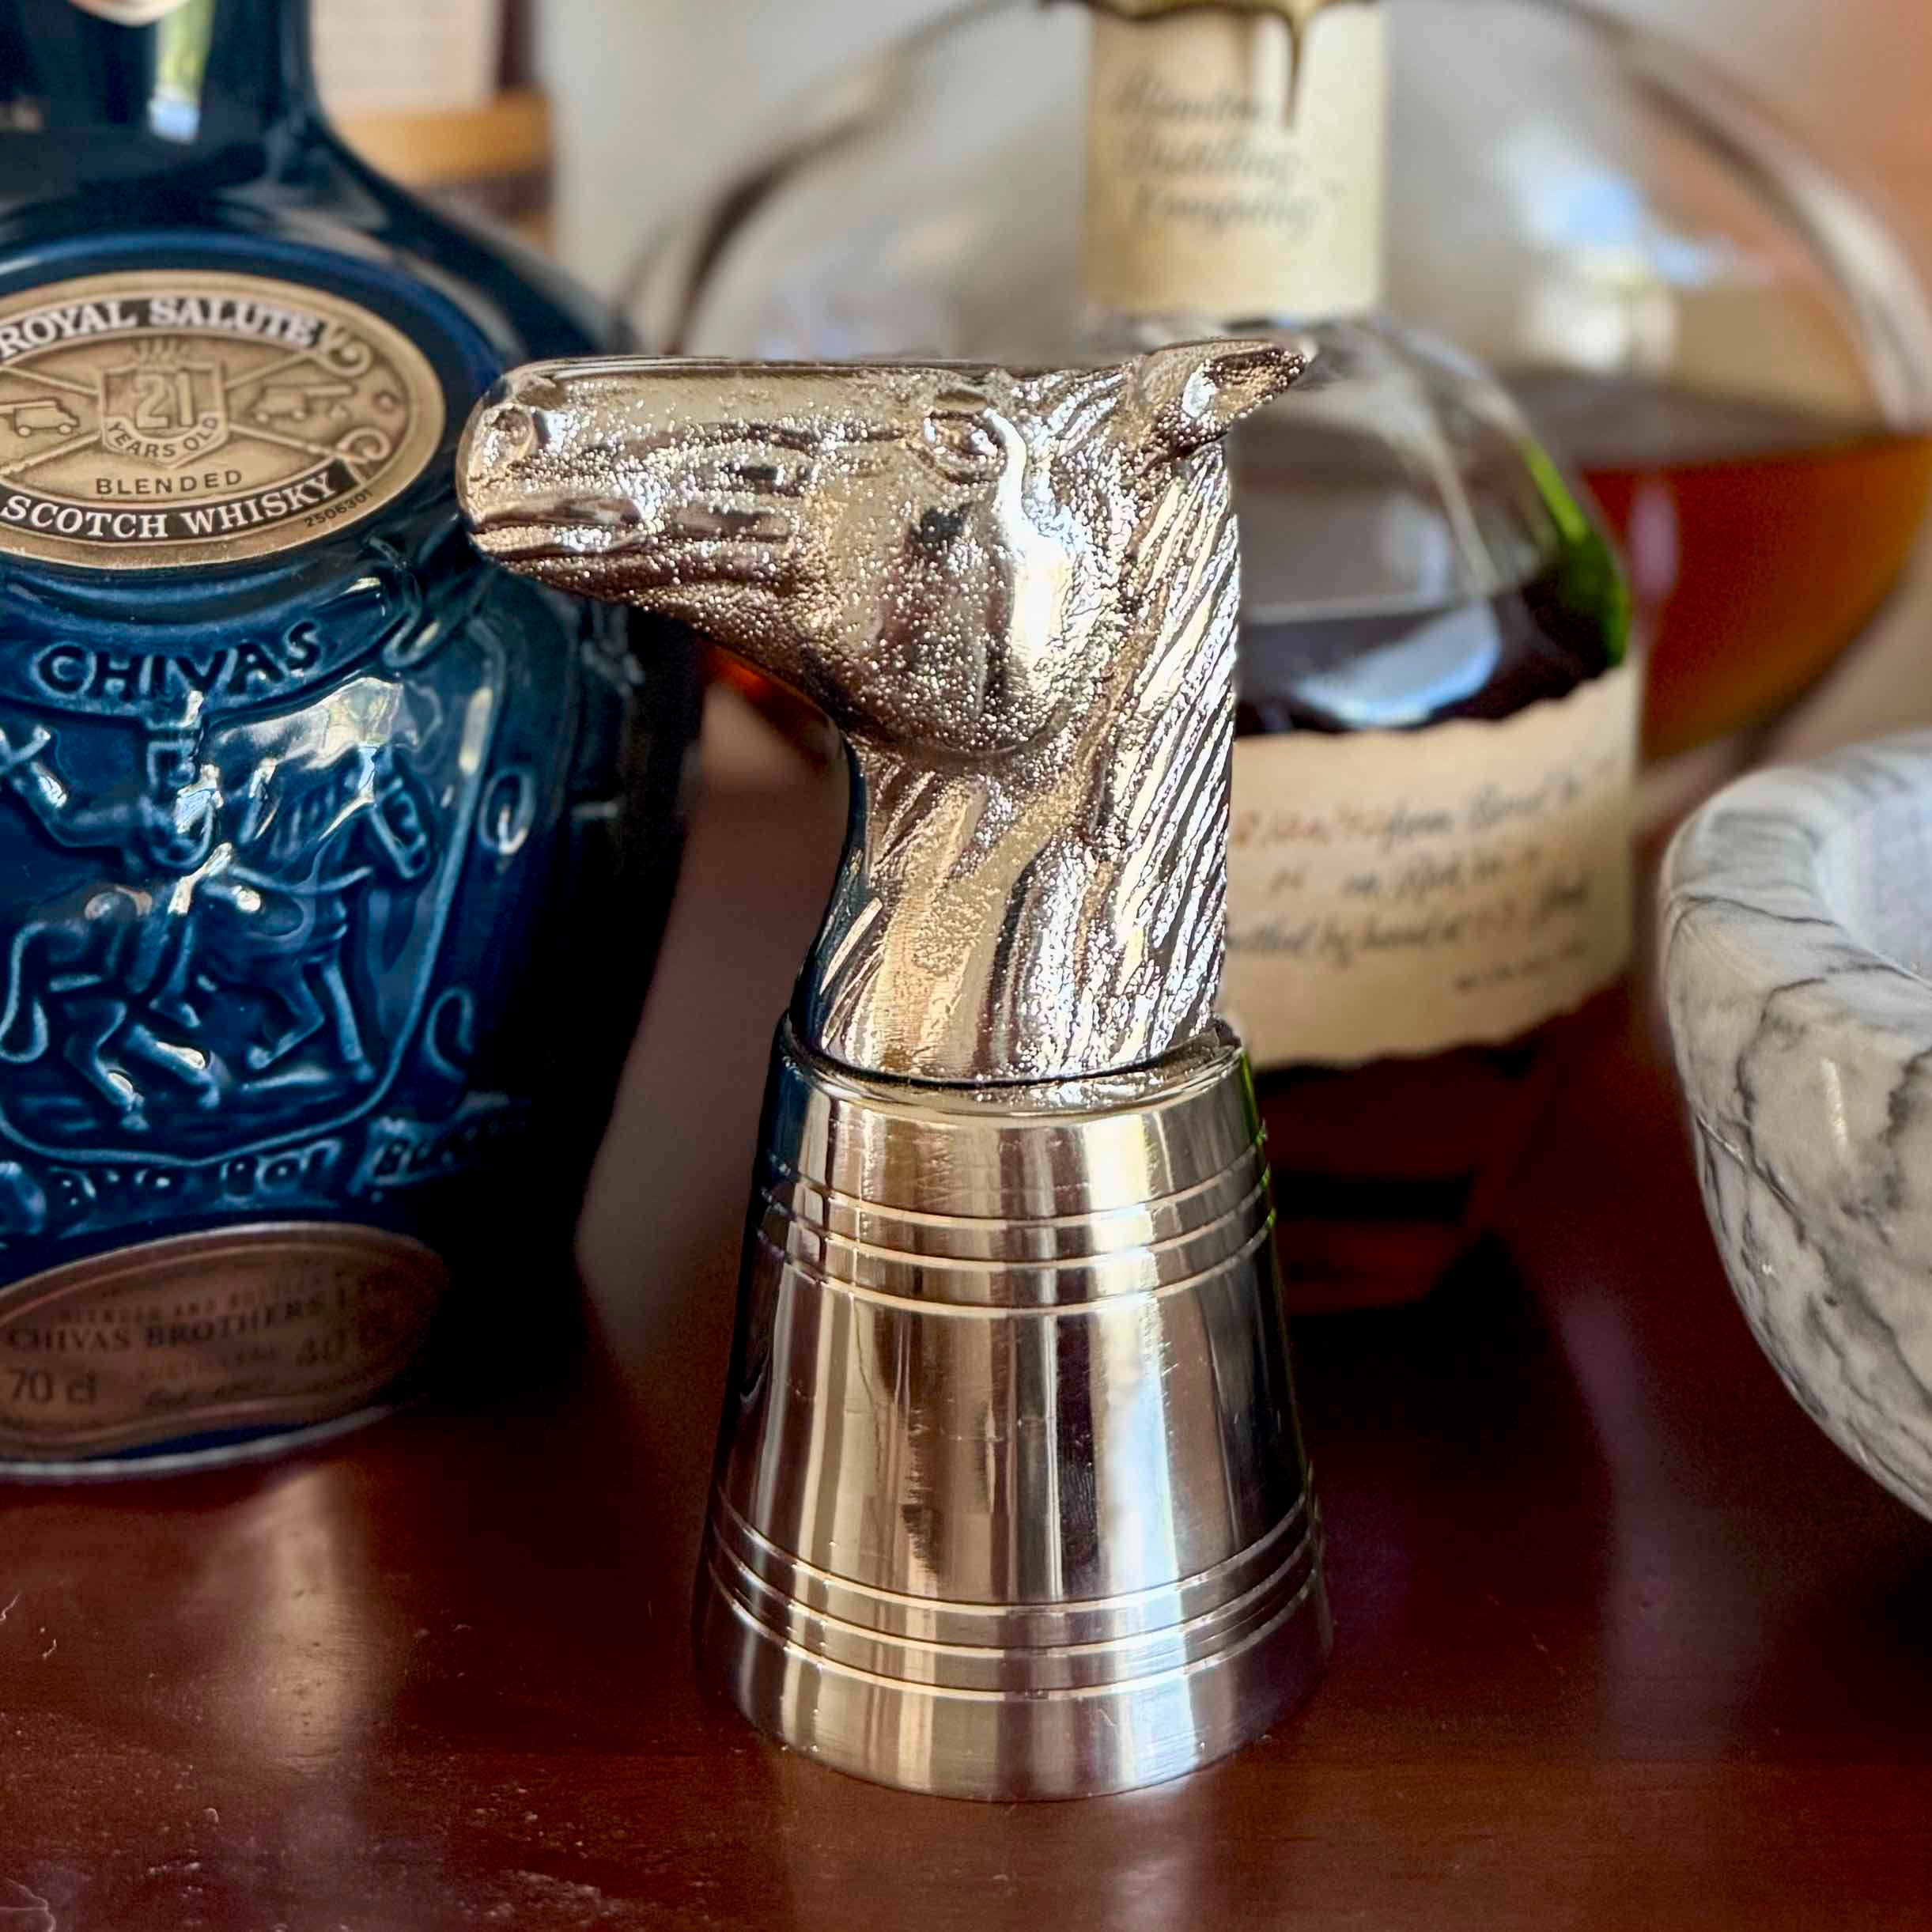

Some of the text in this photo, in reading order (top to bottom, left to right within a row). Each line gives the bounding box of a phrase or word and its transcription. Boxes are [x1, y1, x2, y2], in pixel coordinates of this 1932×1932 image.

[0, 297, 319, 357] ROYAL SALUTE
[136, 372, 194, 429] 21
[108, 417, 218, 458] YEARS OLD
[2, 473, 337, 539] SCOTCH WHISKY
[96, 469, 244, 495] BLENDED
[32, 622, 320, 698] CHIVAS
[6, 1329, 130, 1352] CHIVAS
[7, 1369, 52, 1405] 70
